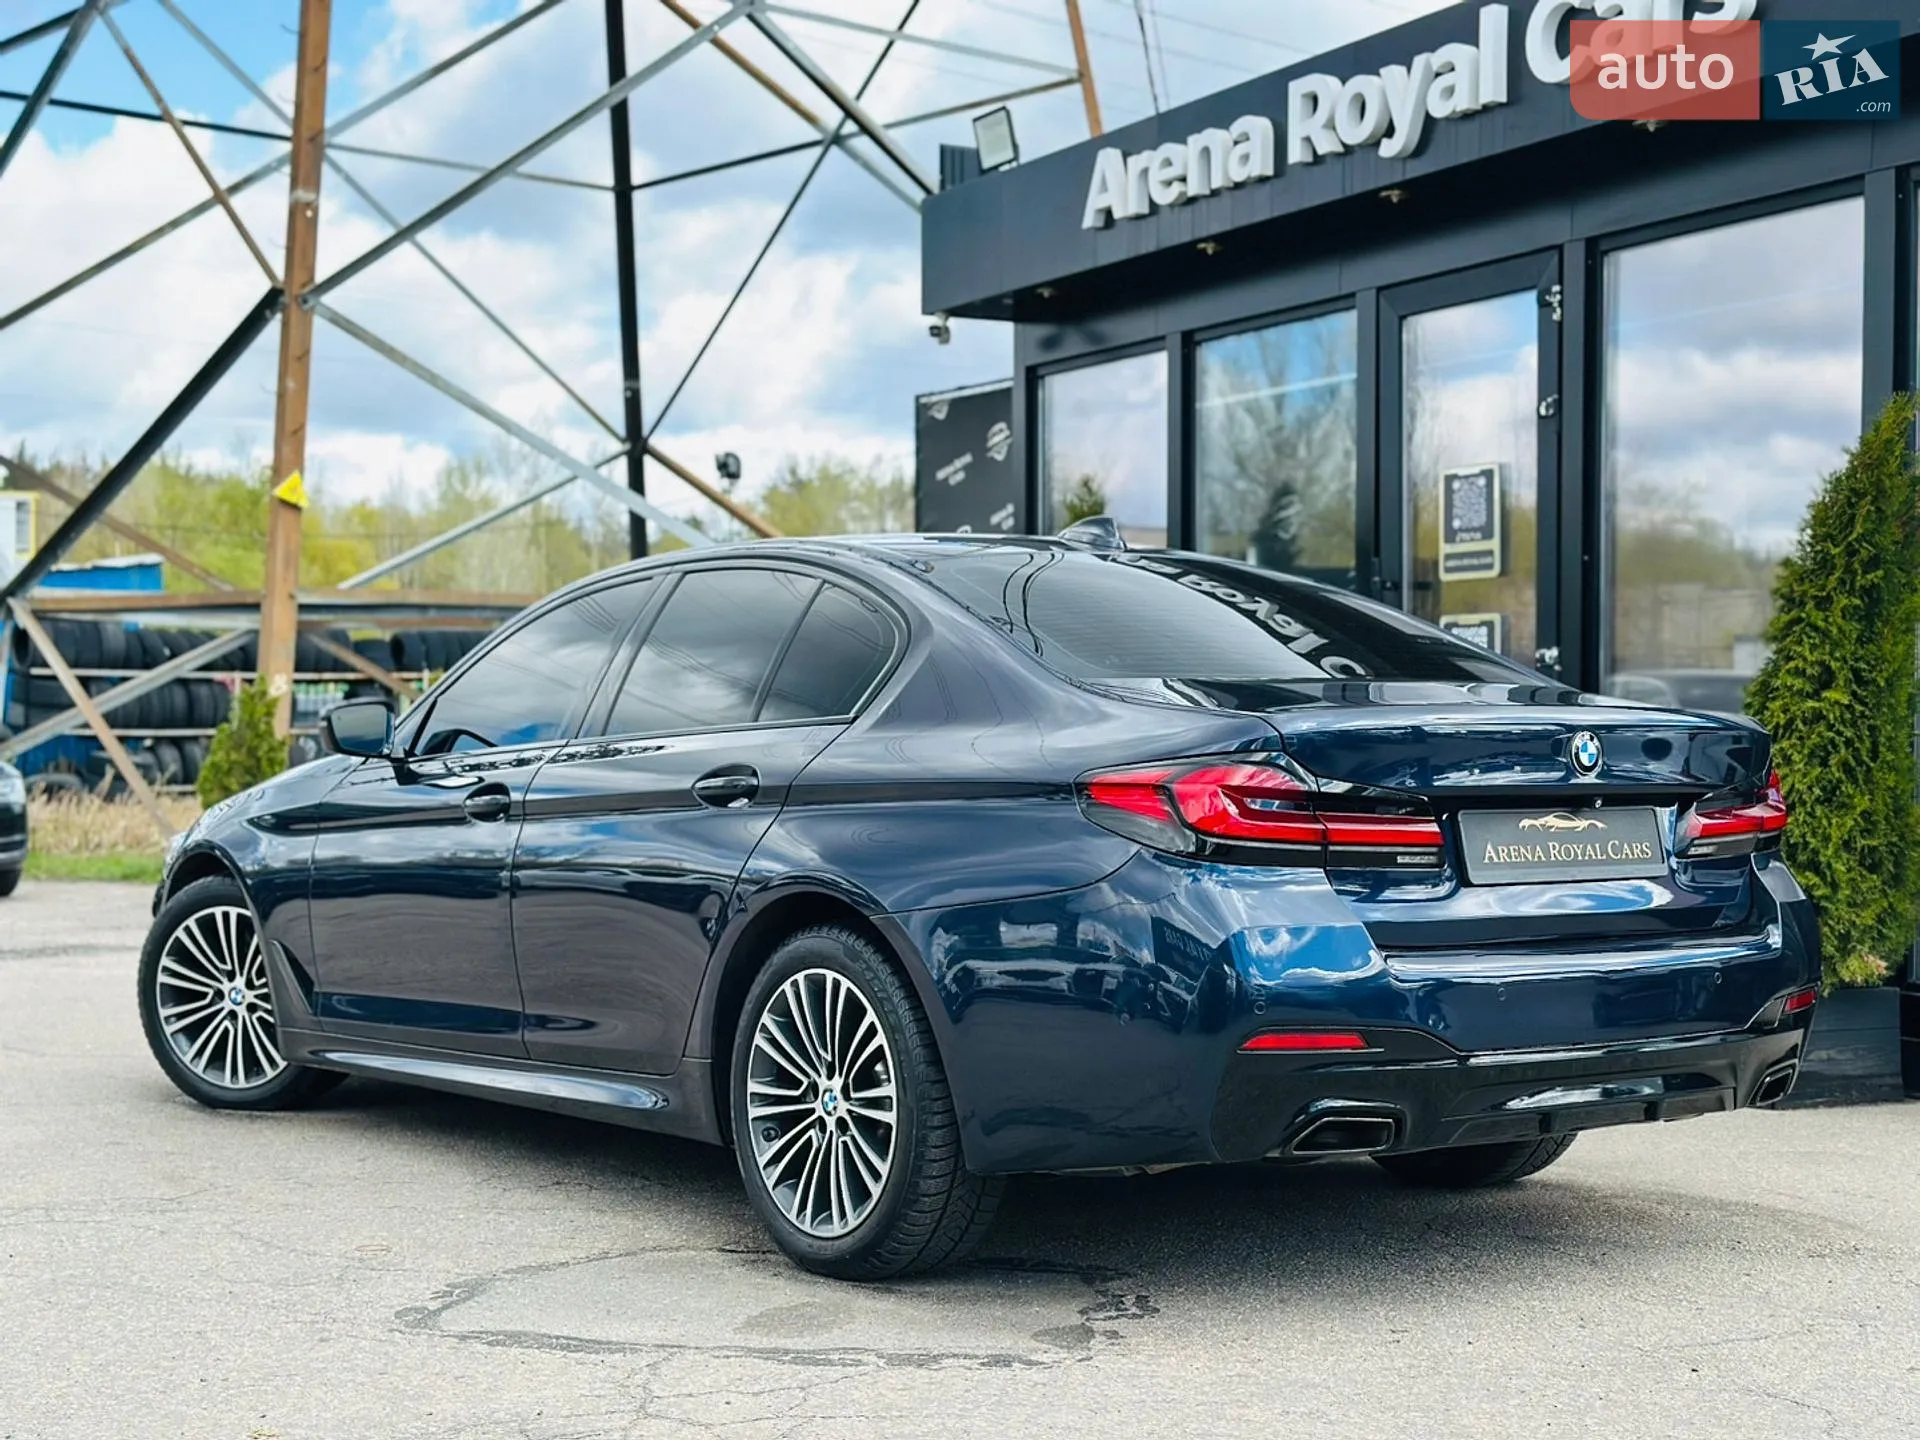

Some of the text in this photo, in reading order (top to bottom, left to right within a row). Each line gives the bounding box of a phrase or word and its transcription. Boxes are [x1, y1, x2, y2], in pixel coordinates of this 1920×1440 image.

[1081, 115, 1275, 229] Arena
[1287, 3, 1509, 165] Royal
[1483, 839, 1652, 864] ARENA ROYAL CARS
